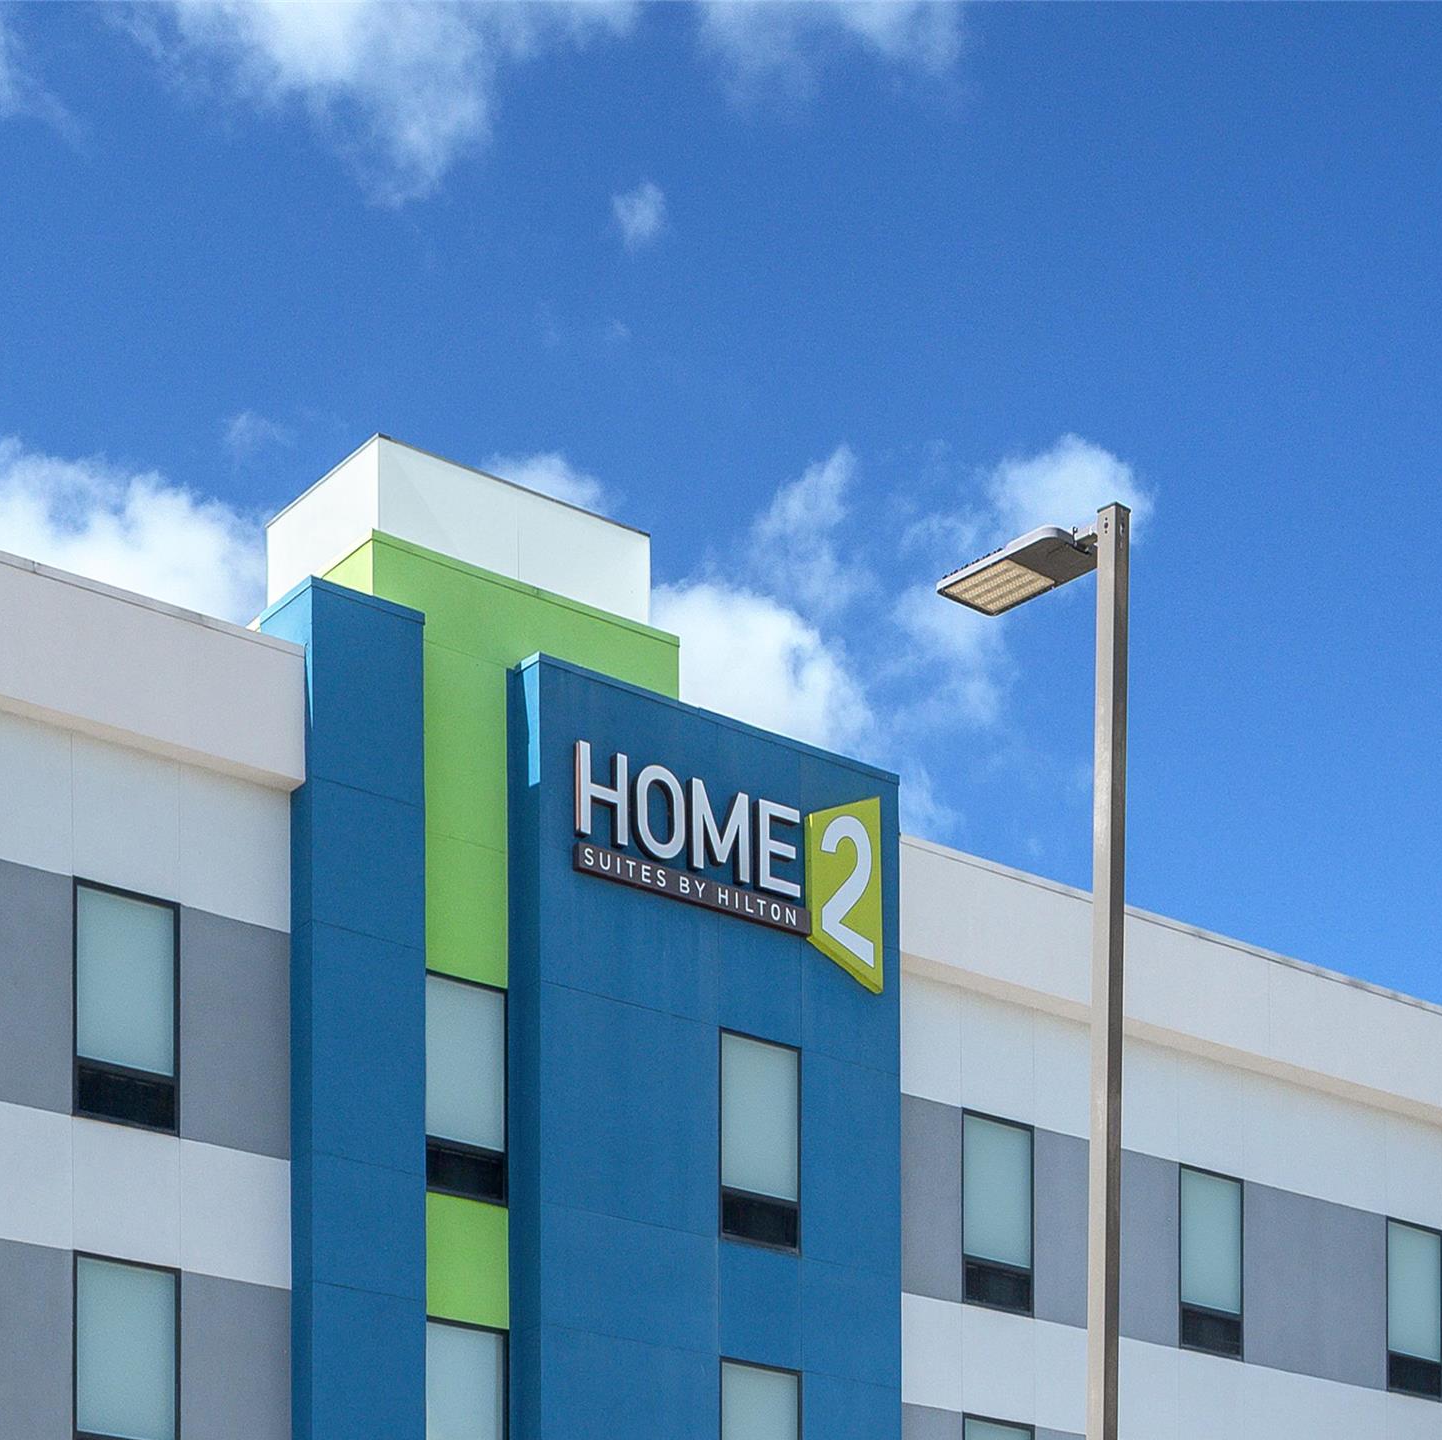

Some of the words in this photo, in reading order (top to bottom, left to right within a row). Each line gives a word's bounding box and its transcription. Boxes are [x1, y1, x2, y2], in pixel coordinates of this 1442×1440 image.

[574, 739, 801, 898] HOME
[820, 815, 875, 969] 2
[584, 848, 667, 888] SUITES
[679, 875, 706, 899] BY
[718, 886, 797, 926] HILTON
